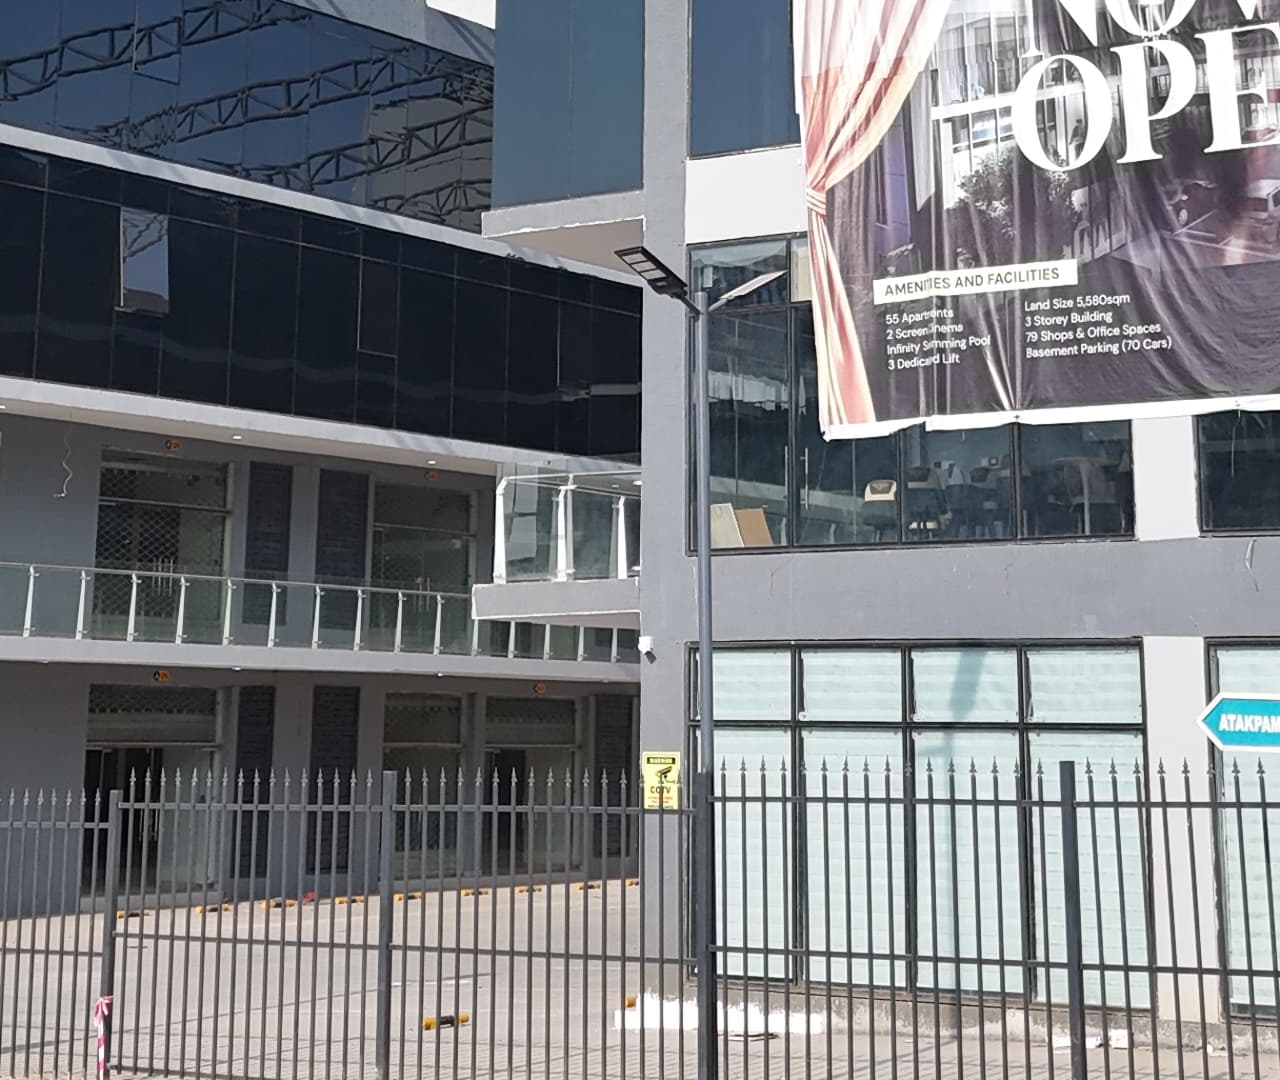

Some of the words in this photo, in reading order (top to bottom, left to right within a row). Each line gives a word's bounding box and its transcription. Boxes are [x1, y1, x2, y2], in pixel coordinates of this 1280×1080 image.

[954, 274, 984, 289] AND
[987, 267, 1061, 286] FACILITIES
[1024, 299, 1050, 312] Land
[1052, 297, 1074, 310] Size
[1076, 294, 1131, 309] 5,580sqm
[885, 313, 900, 325] 55
[901, 309, 955, 324] Apartents
[1024, 316, 1032, 327] 3
[1033, 314, 1069, 328] Storey
[1070, 311, 1113, 324] Building
[886, 329, 894, 340] 2
[1025, 331, 1038, 343] 79
[1040, 329, 1074, 343] Shops
[1075, 327, 1085, 339] &
[1087, 326, 1121, 338] Office
[1122, 322, 1162, 337] Spaces
[886, 342, 921, 355] Infinity
[968, 334, 991, 347] Pool
[1025, 345, 1079, 359] Basement
[1080, 342, 1120, 356] Parking
[1121, 339, 1141, 353] (70
[1142, 335, 1173, 351] Cars)
[887, 359, 895, 371] 3
[942, 352, 961, 364] Lift
